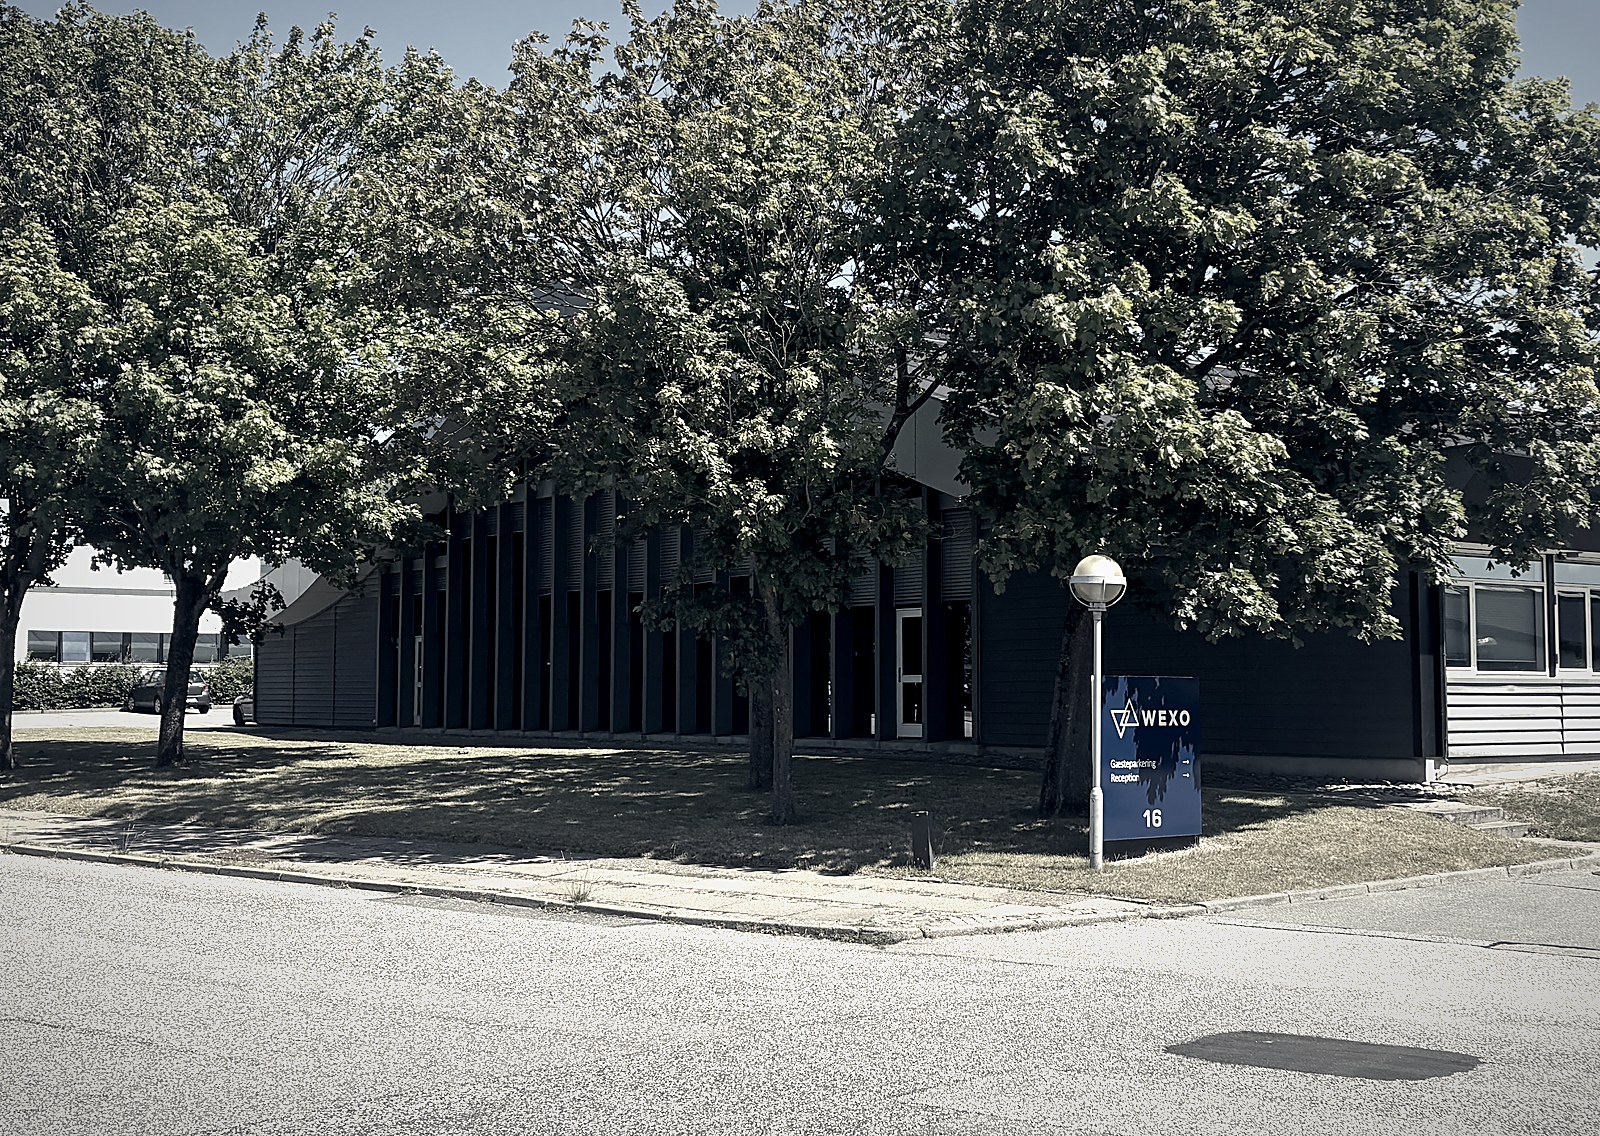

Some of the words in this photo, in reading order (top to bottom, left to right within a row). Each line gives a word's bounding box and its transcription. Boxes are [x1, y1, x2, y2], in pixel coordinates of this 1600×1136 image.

[1141, 710, 1191, 727] WEXO
[1110, 759, 1157, 770] Gæsteparkering
[1110, 773, 1140, 784] Reception
[1142, 809, 1162, 828] 16
